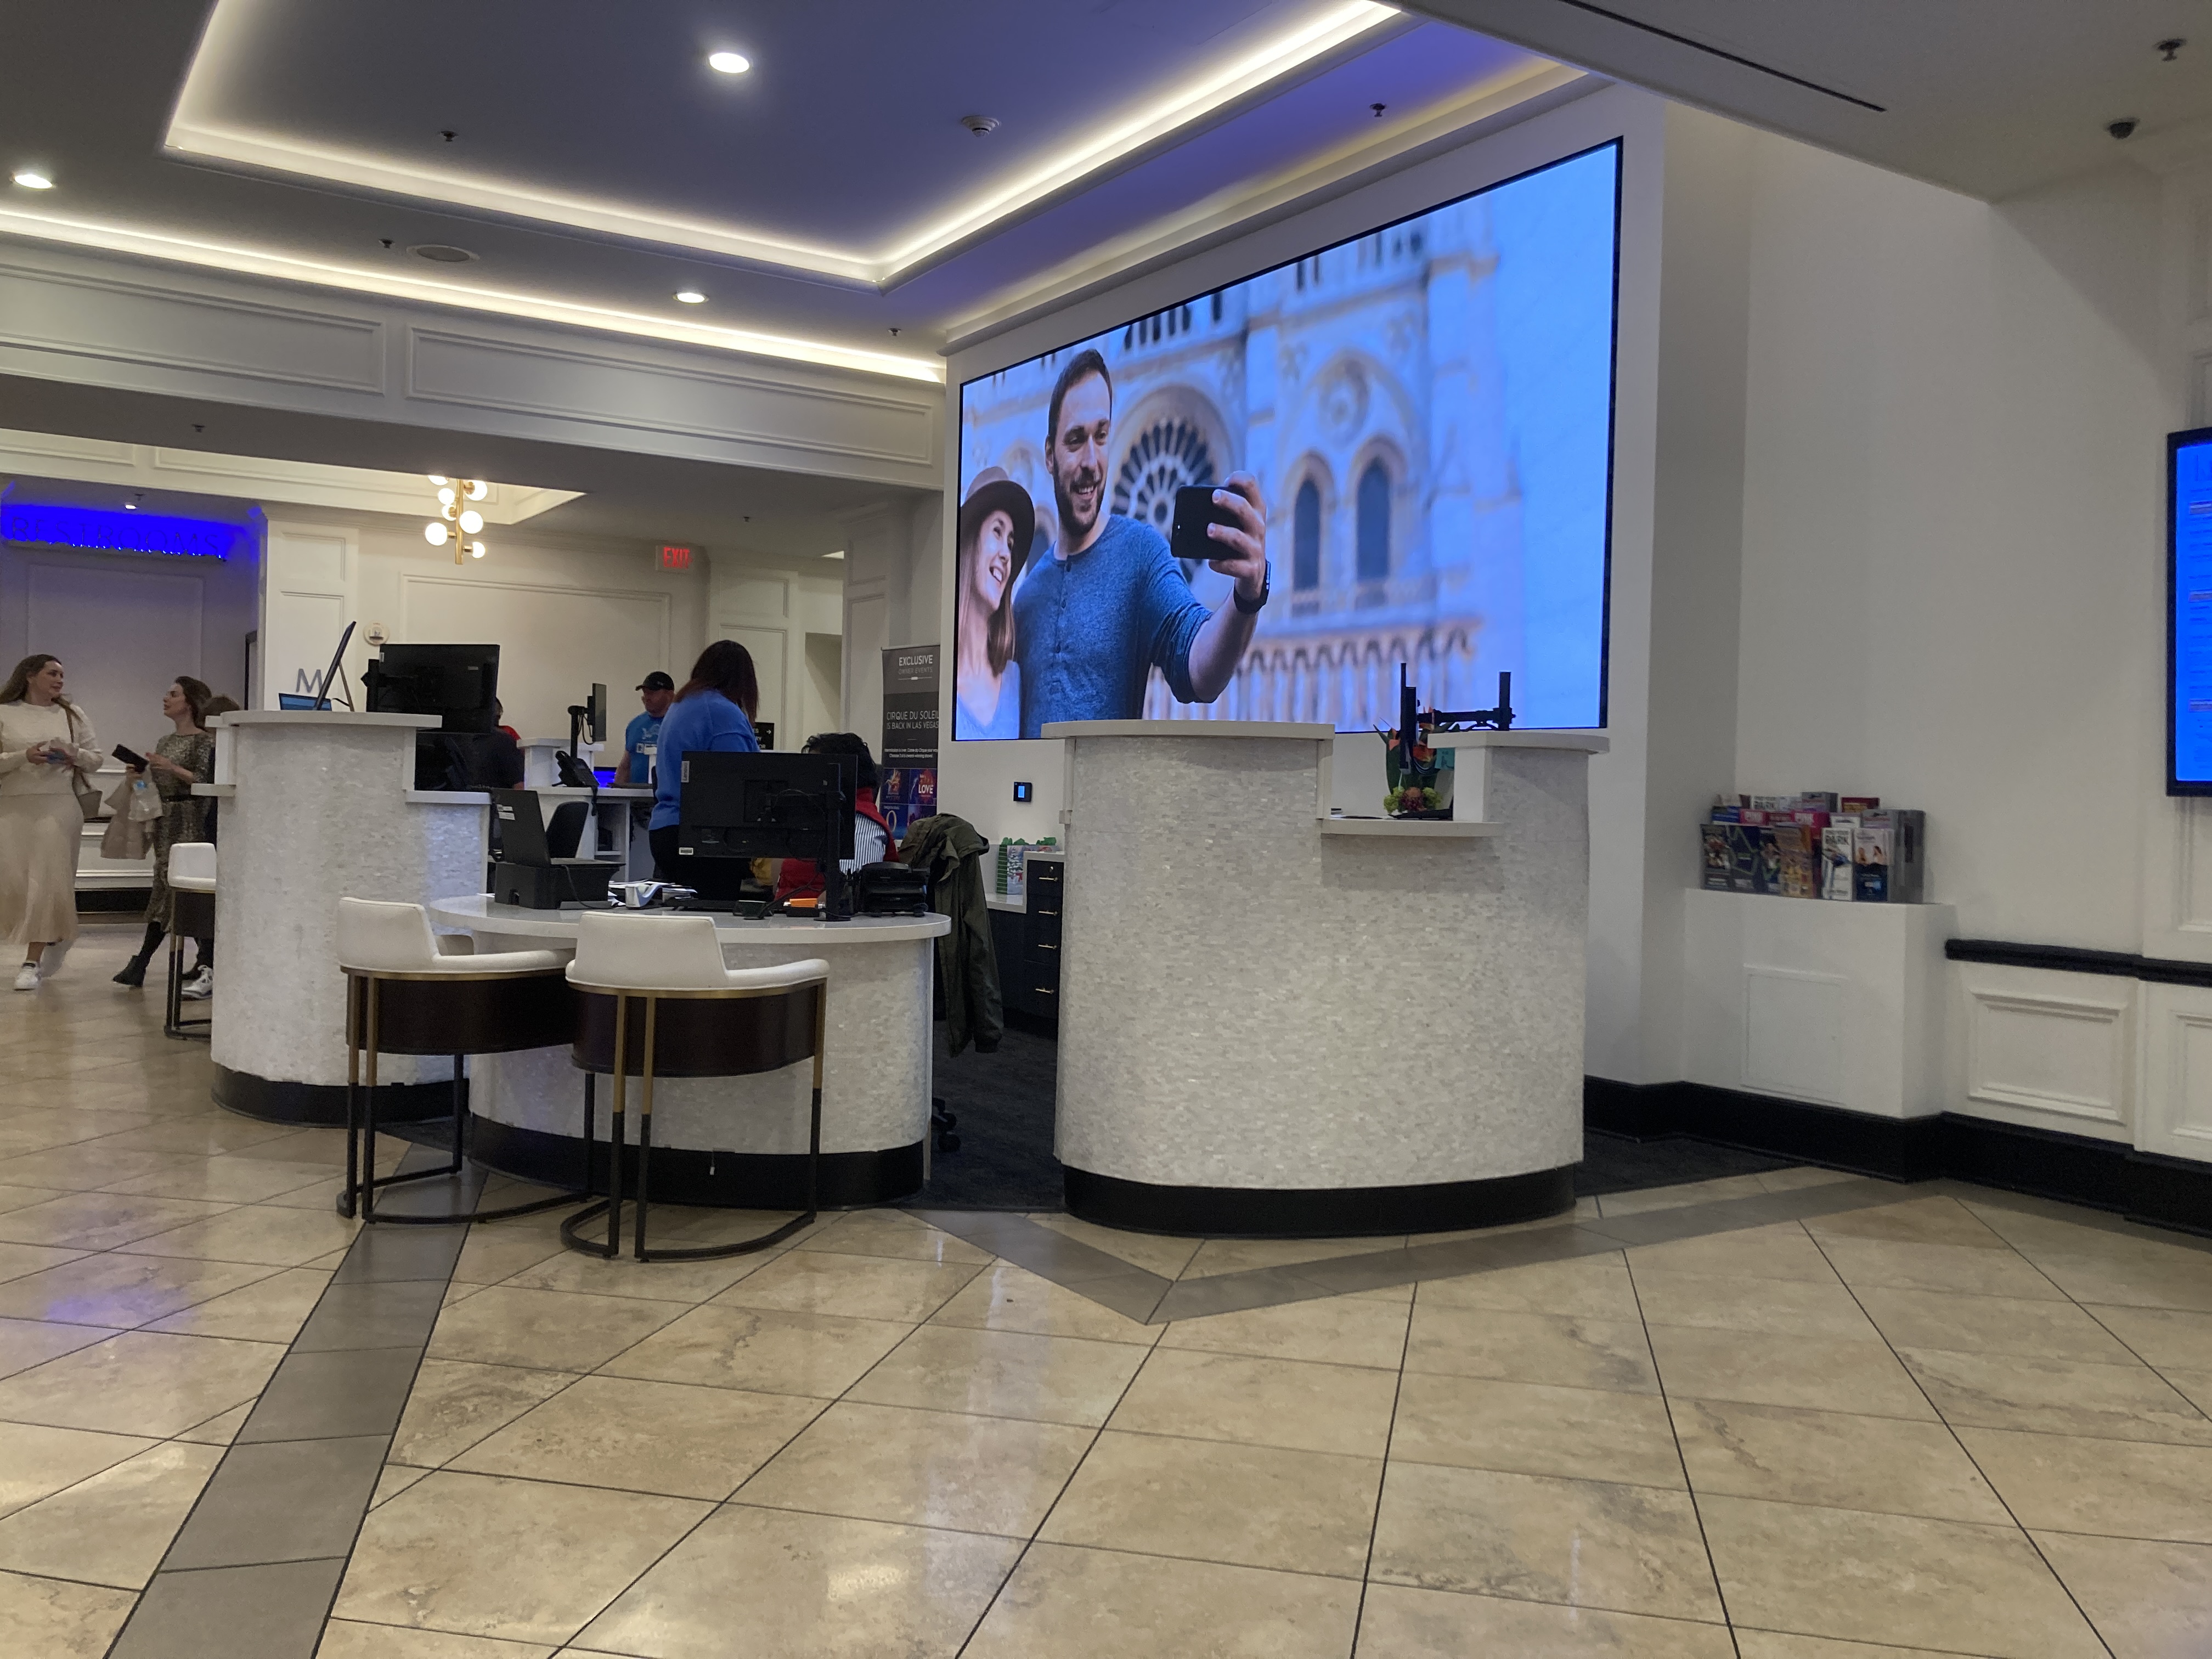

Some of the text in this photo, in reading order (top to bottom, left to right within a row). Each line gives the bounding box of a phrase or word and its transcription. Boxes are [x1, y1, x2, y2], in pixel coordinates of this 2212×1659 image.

[12, 516, 221, 557] RESTROOMS
[663, 546, 690, 569] EXIT
[899, 654, 933, 666] EXCLUSIVE
[887, 710, 939, 720] CIRQUE DU SOLEIL
[918, 785, 934, 794] LOVE
